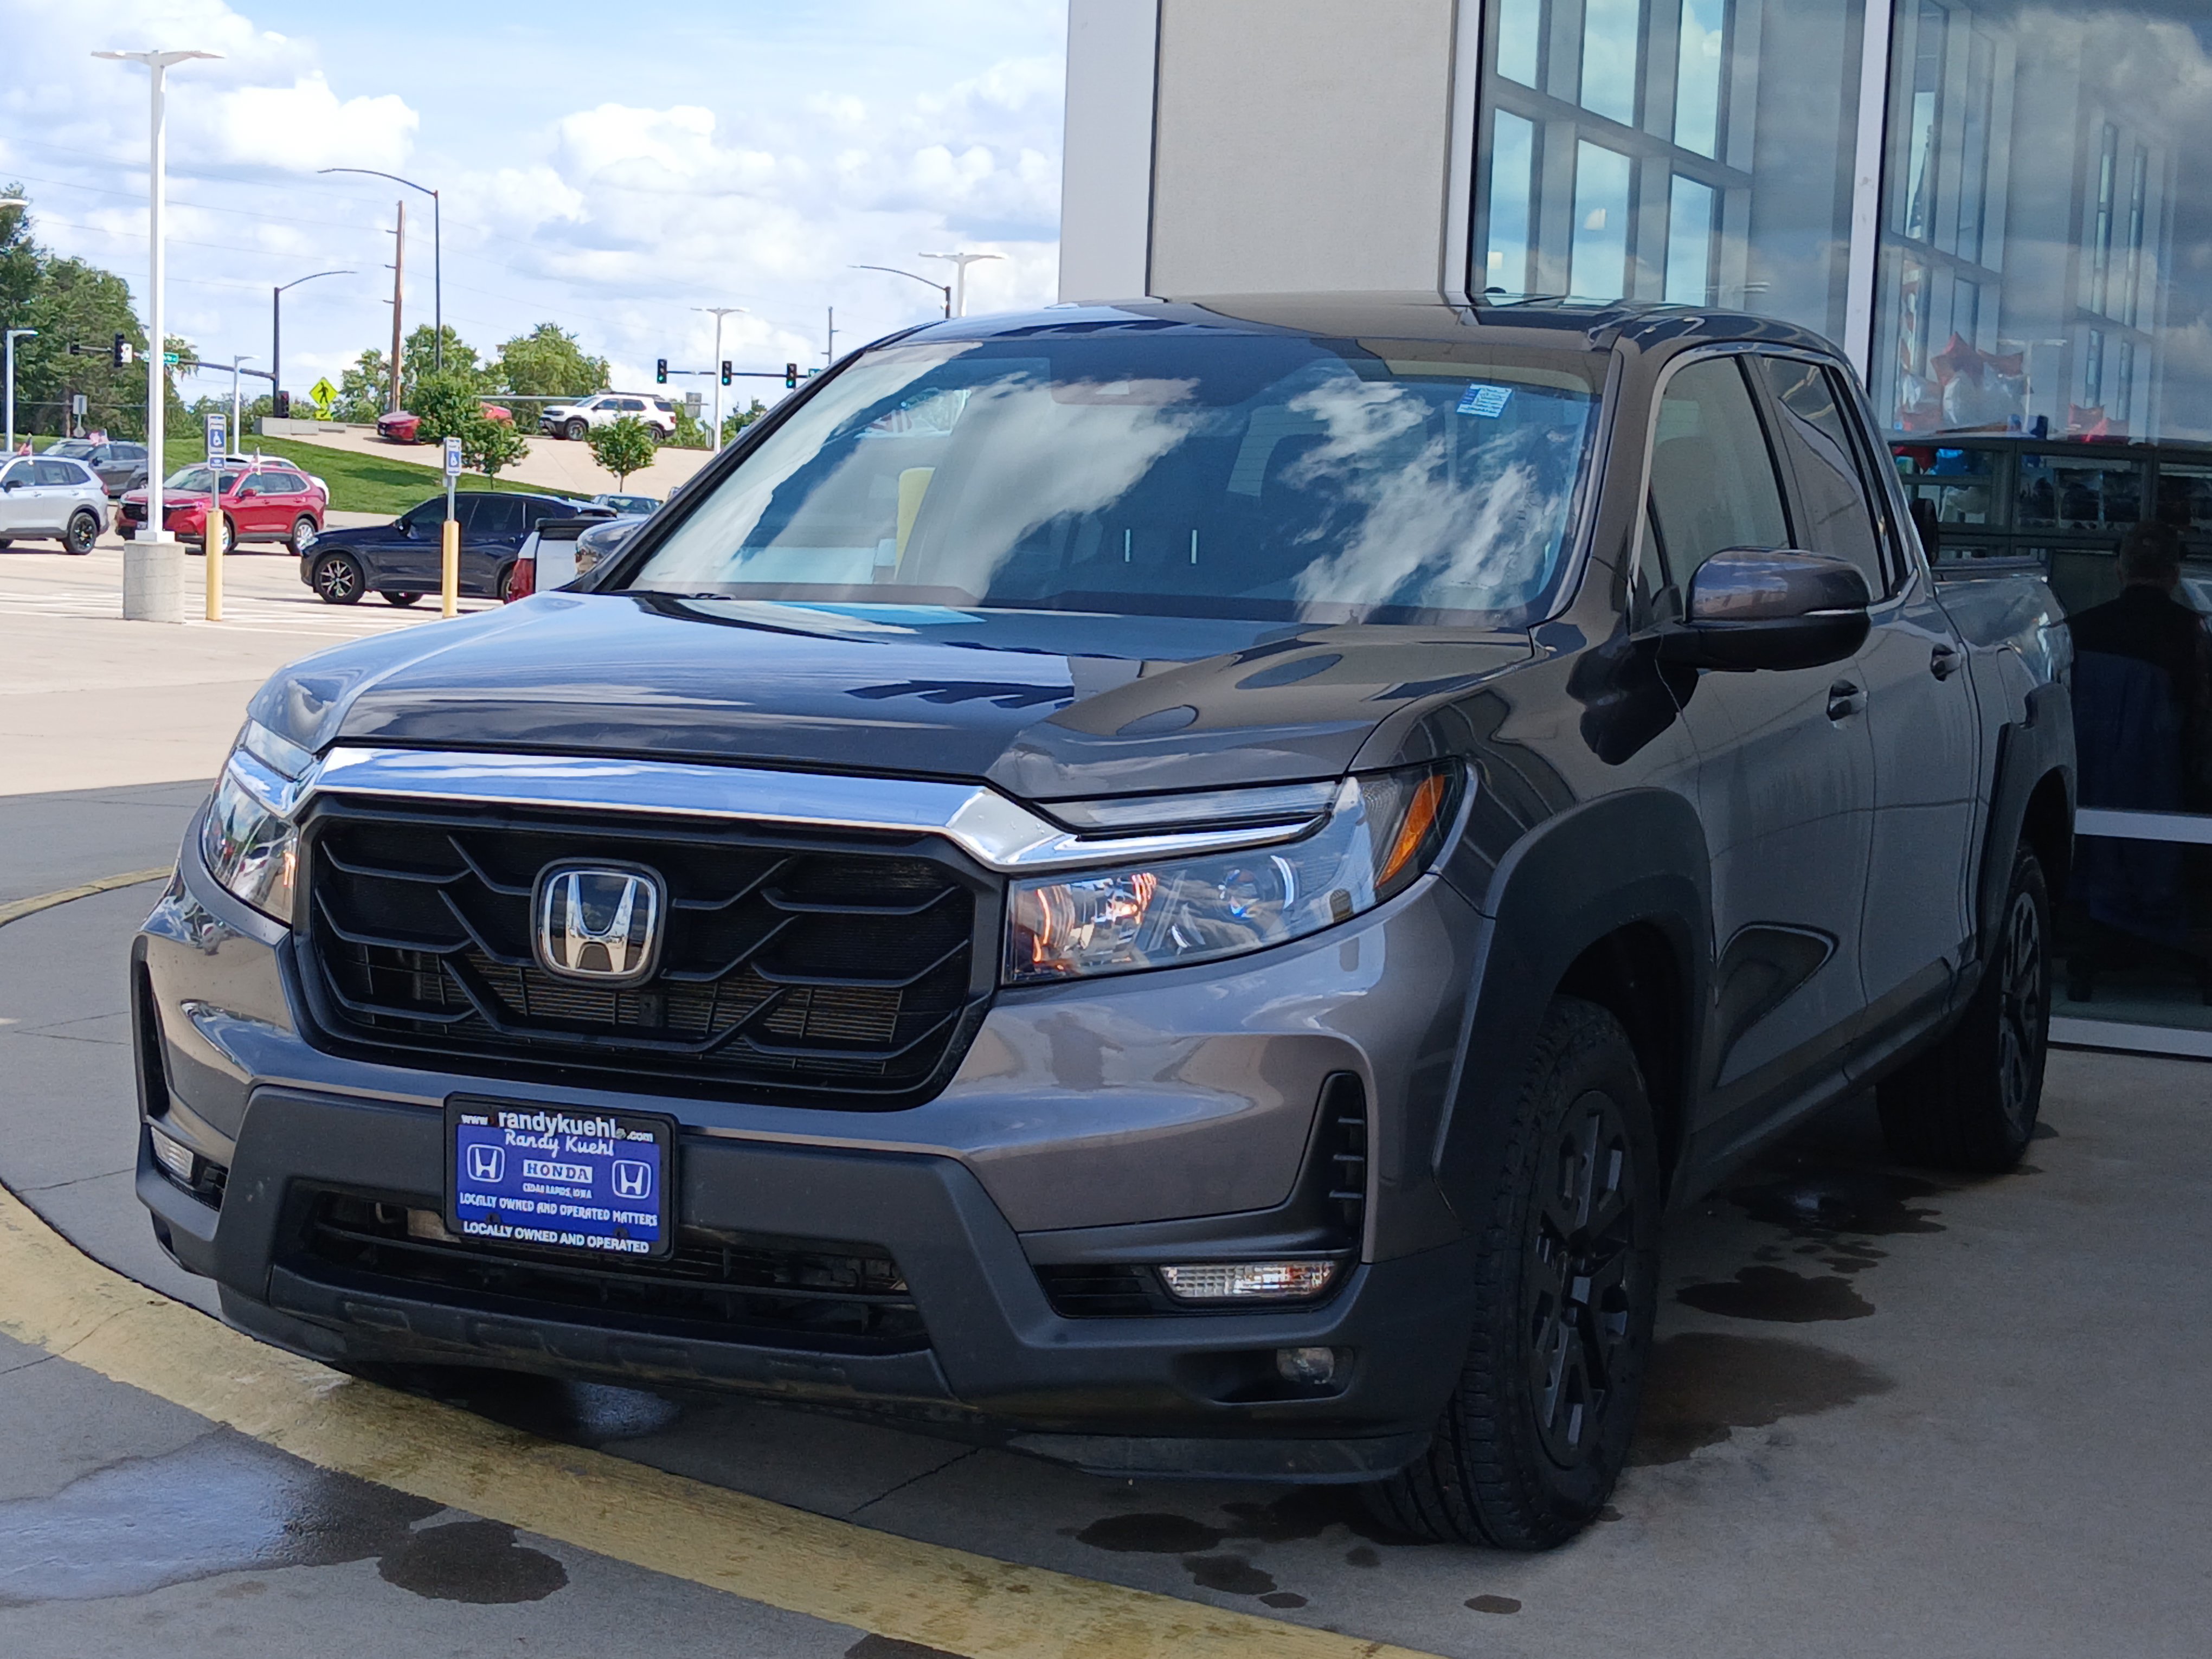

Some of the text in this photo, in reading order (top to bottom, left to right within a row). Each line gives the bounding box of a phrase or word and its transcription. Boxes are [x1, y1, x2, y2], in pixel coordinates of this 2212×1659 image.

[498, 1111, 616, 1138] randykuehl
[504, 1128, 614, 1158] Randy Kuehl
[526, 1163, 589, 1180] HONDA
[460, 1192, 658, 1226] LOCALLY OWNED AND OPERATED MATTERS
[464, 1221, 650, 1253] LOCALLY OWNED AND OPERATED
